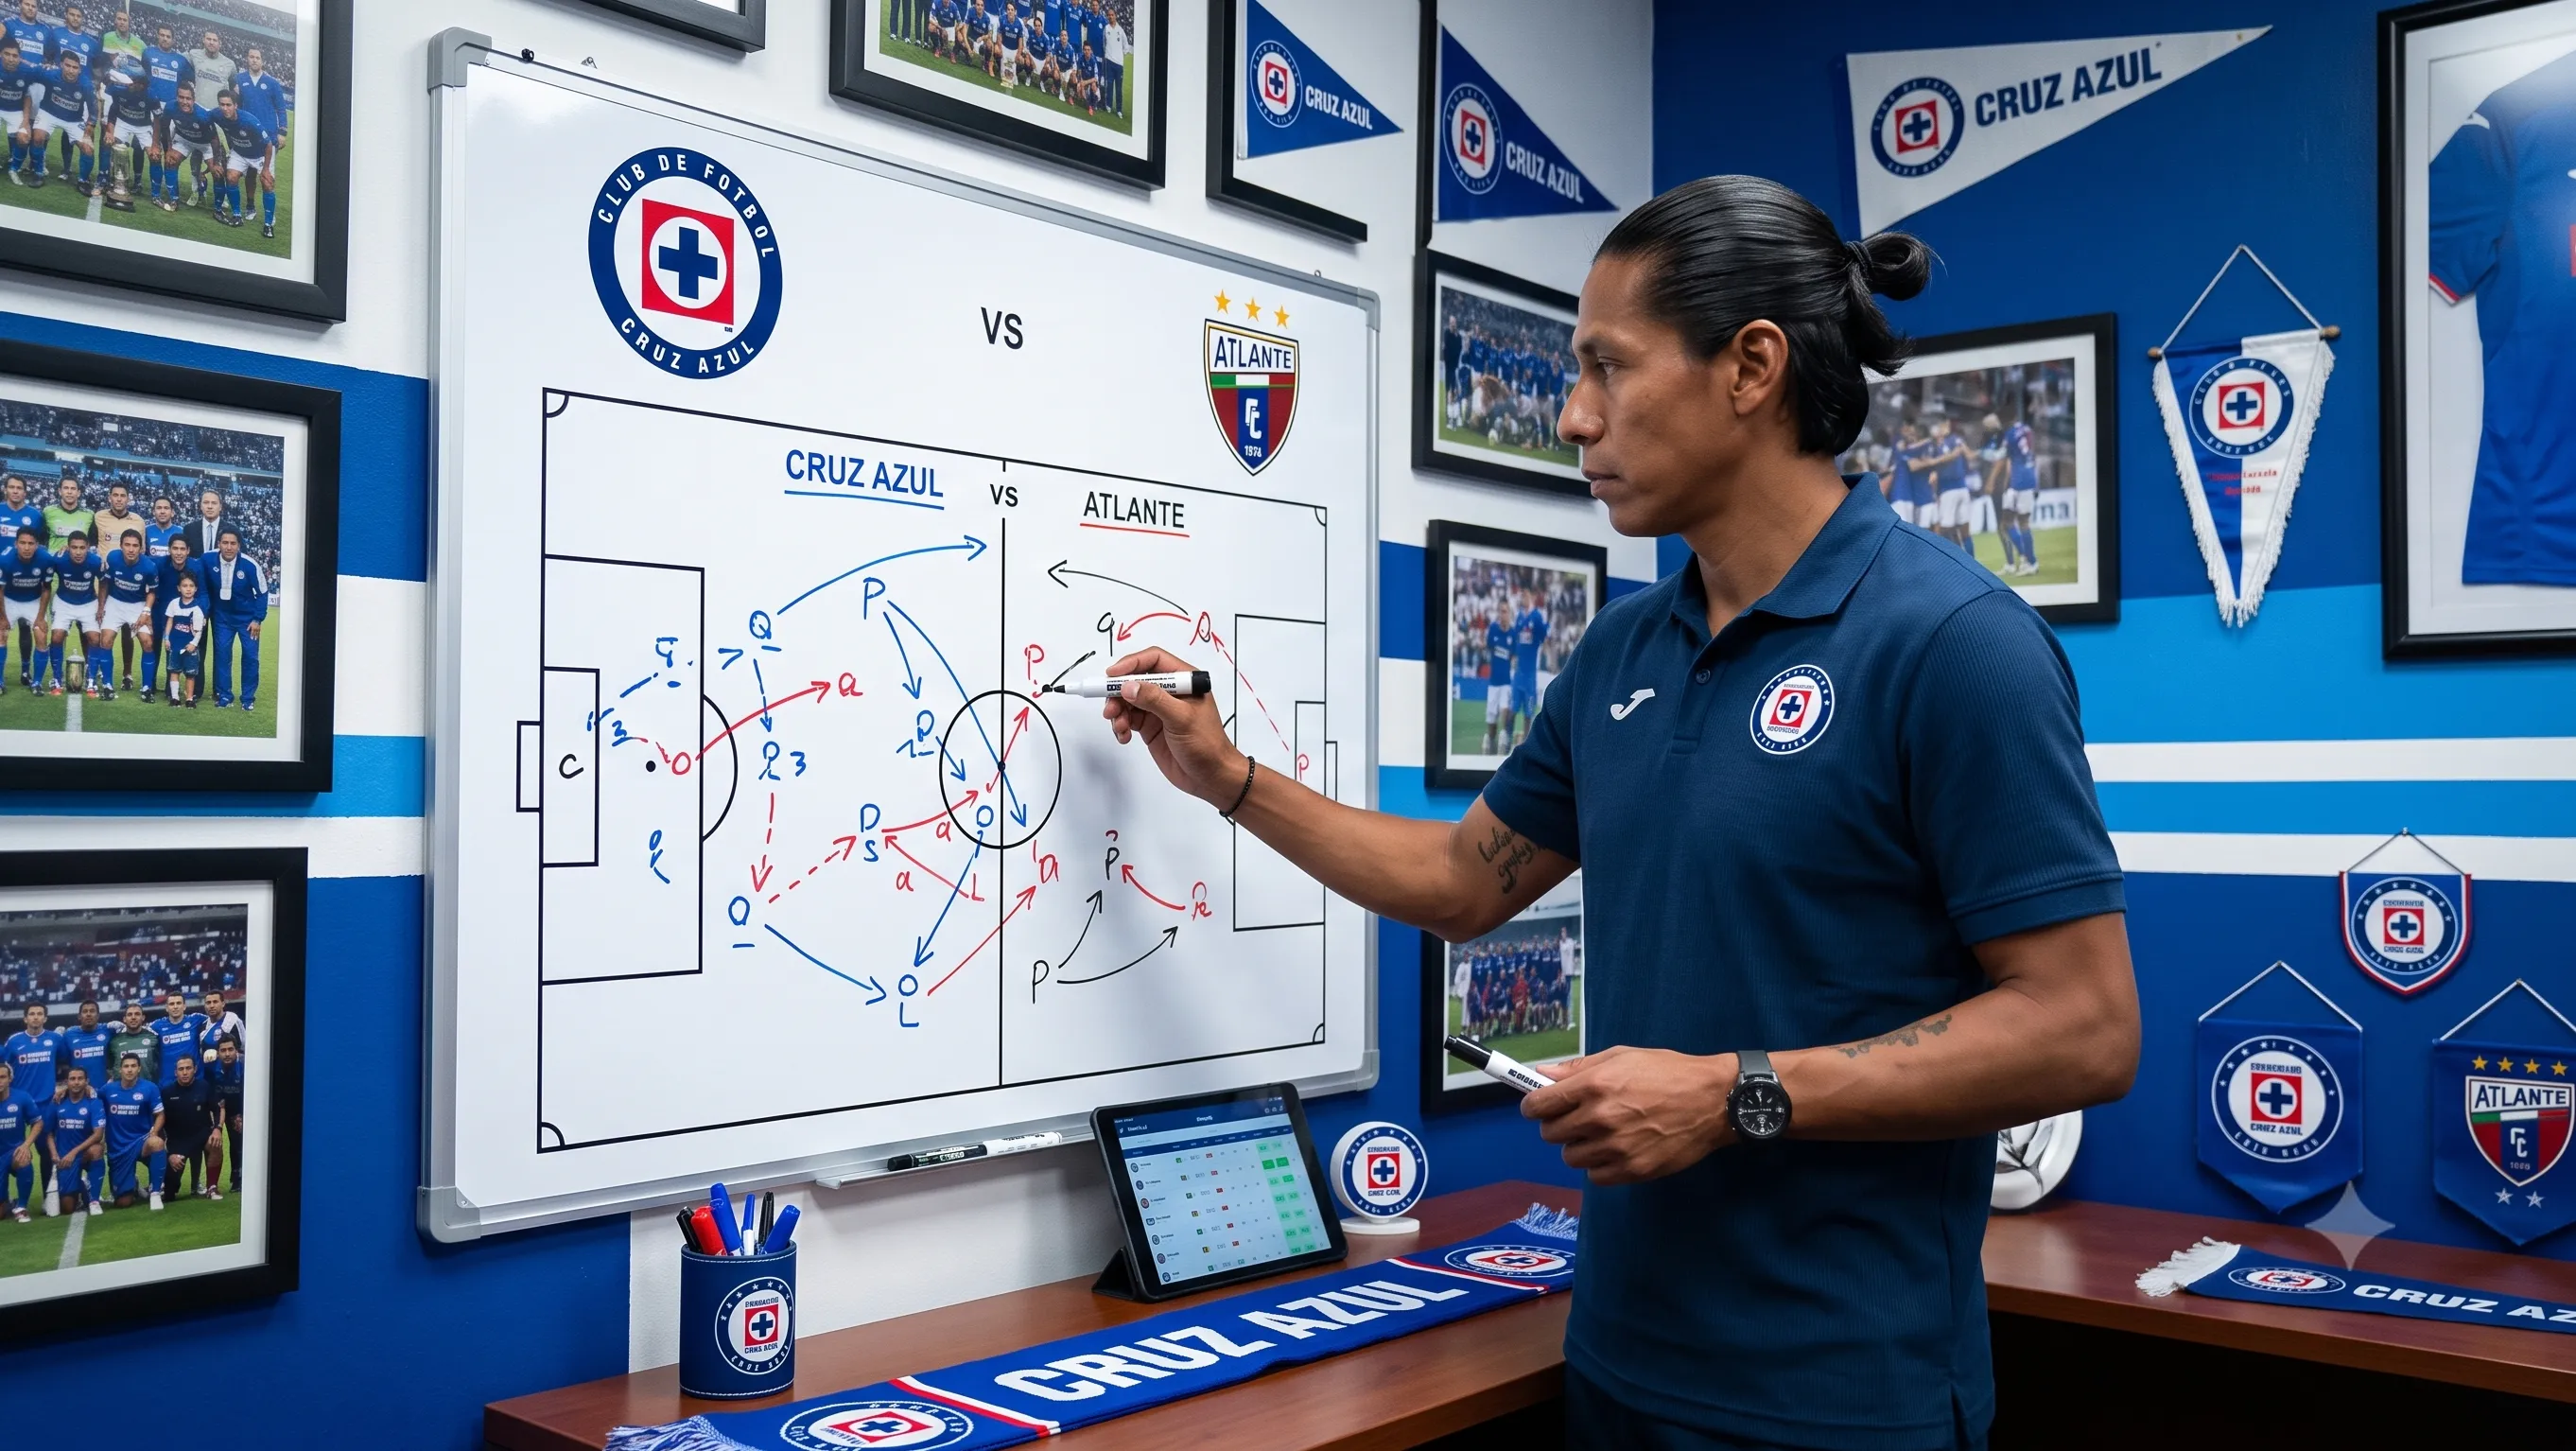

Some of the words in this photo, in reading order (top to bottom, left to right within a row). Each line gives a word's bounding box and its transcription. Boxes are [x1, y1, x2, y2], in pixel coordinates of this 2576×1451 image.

[1305, 85, 1340, 117] CRUZ
[1341, 99, 1373, 131] AZUL
[1975, 72, 2063, 128] CRUZ
[2071, 48, 2162, 103] AZUL
[1506, 140, 1545, 184] CRUZ
[1547, 163, 1584, 203] AZUL
[598, 163, 645, 223] CLUB
[658, 154, 687, 171] DE
[704, 163, 774, 257] FOTBOL
[621, 318, 681, 370] CRUZ
[698, 341, 754, 373] AZUL
[981, 307, 1024, 350] VS
[1214, 336, 1292, 369] ATLANTE
[786, 449, 864, 488] CRUZ
[872, 463, 944, 498] AZUL
[990, 484, 1018, 507] VS
[1084, 491, 1185, 529] ATLANTE
[2475, 1084, 2567, 1109] ATLANTE
[2352, 1285, 2499, 1313] CRUZ
[994, 1325, 1277, 1402] CRUZ
[1239, 1280, 1470, 1339] AZUL
